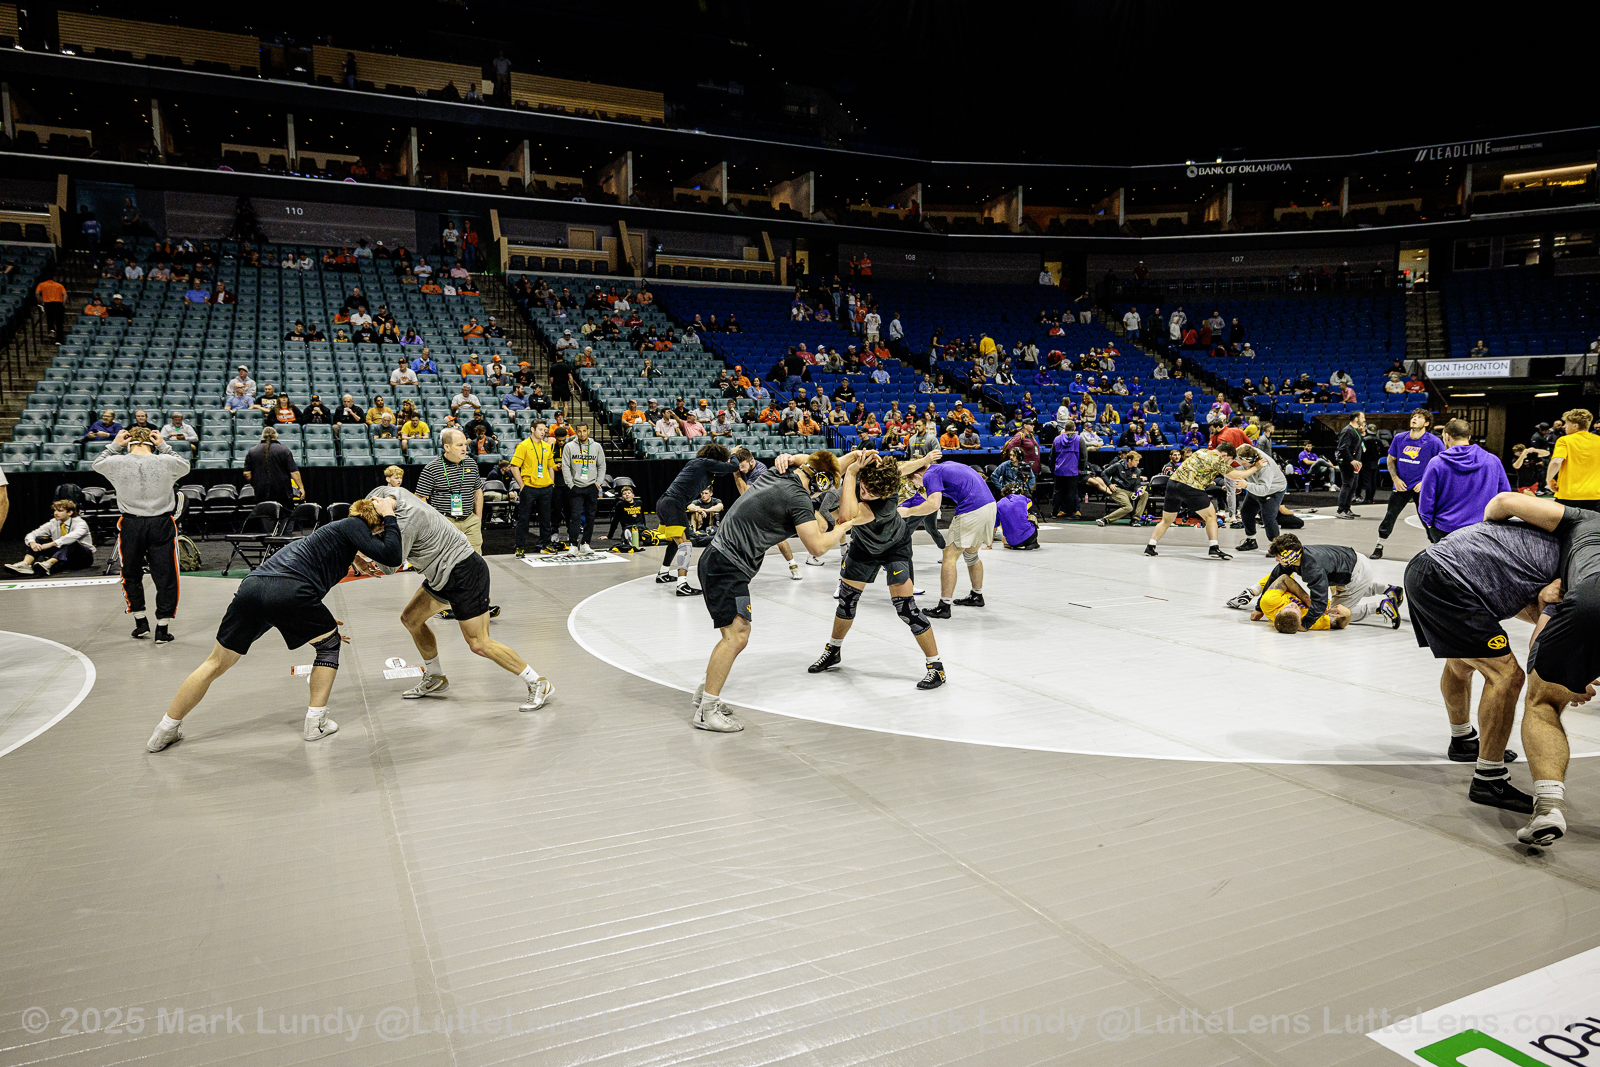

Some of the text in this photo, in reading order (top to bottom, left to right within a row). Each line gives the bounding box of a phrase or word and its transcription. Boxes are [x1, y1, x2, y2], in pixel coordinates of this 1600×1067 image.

[1429, 142, 1491, 161] LEADLINE
[1198, 163, 1292, 176] BANK OF OKLAHOMA
[285, 206, 304, 216] 110
[1231, 255, 1245, 263] 107
[1427, 362, 1508, 372] DON THORNTON
